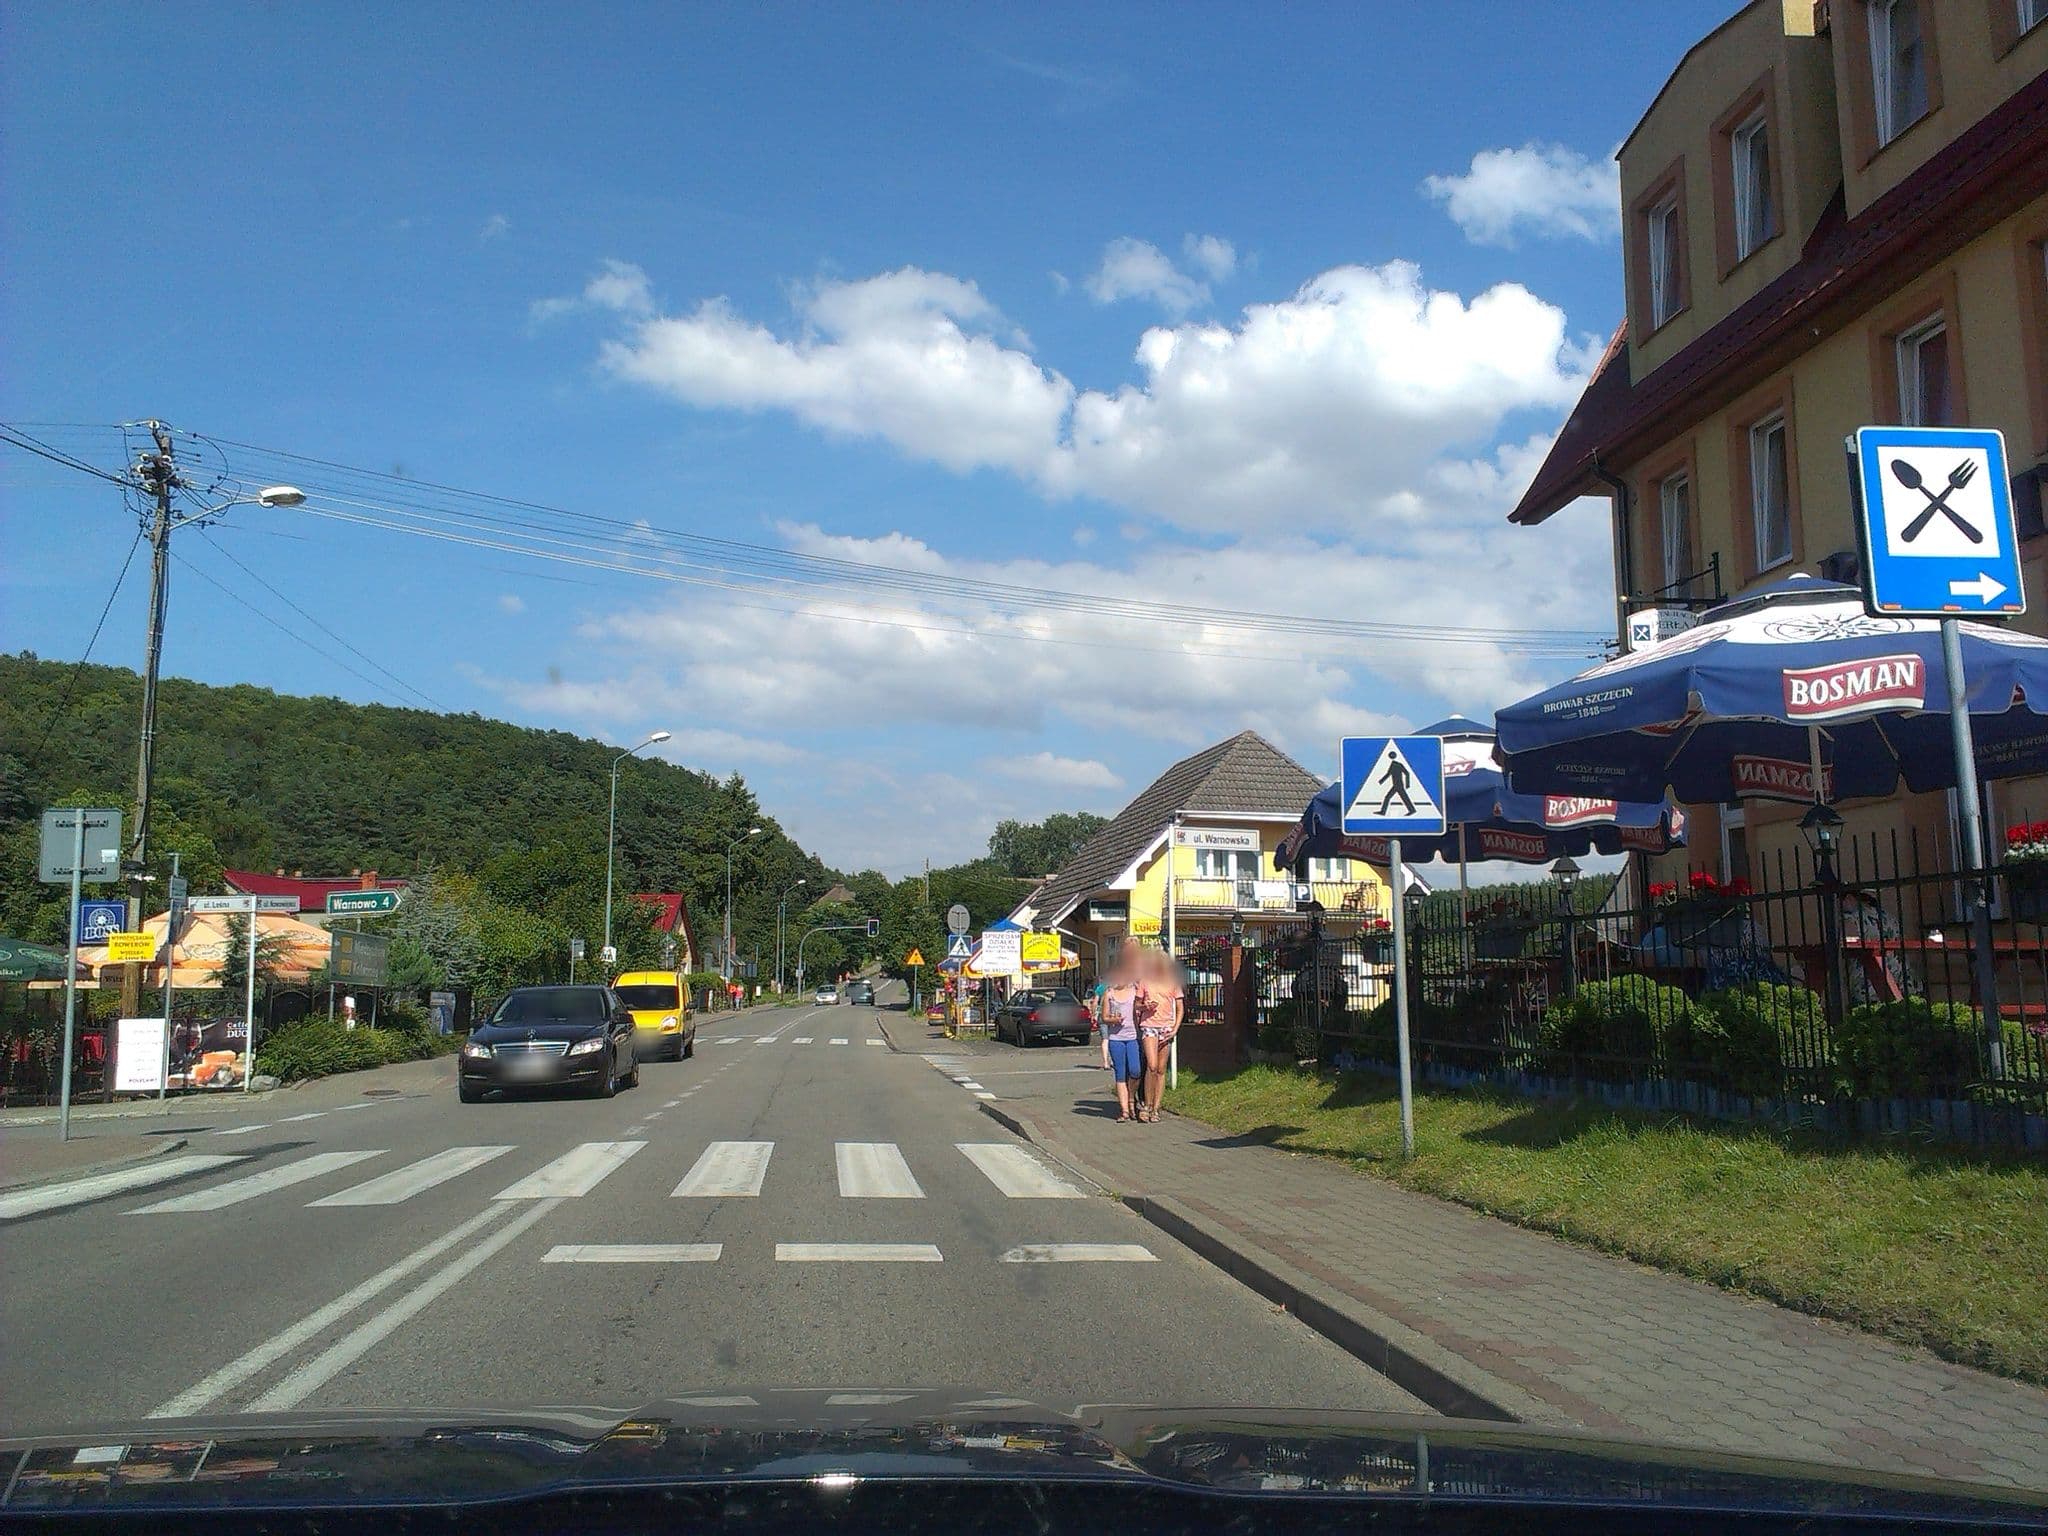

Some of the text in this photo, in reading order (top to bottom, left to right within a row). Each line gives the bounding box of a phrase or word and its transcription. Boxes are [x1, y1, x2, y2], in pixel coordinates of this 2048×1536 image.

[1790, 660, 1917, 706] BOSMAN
[1543, 697, 1584, 713] BROWAR
[1585, 686, 1635, 705] SZCZECIN
[1578, 705, 1600, 718] 1848
[1548, 797, 1613, 818] BOSMAN
[1193, 833, 1250, 846] ul. Warnowska
[333, 896, 390, 910] Warnowo 4
[84, 923, 121, 940] BOSS
